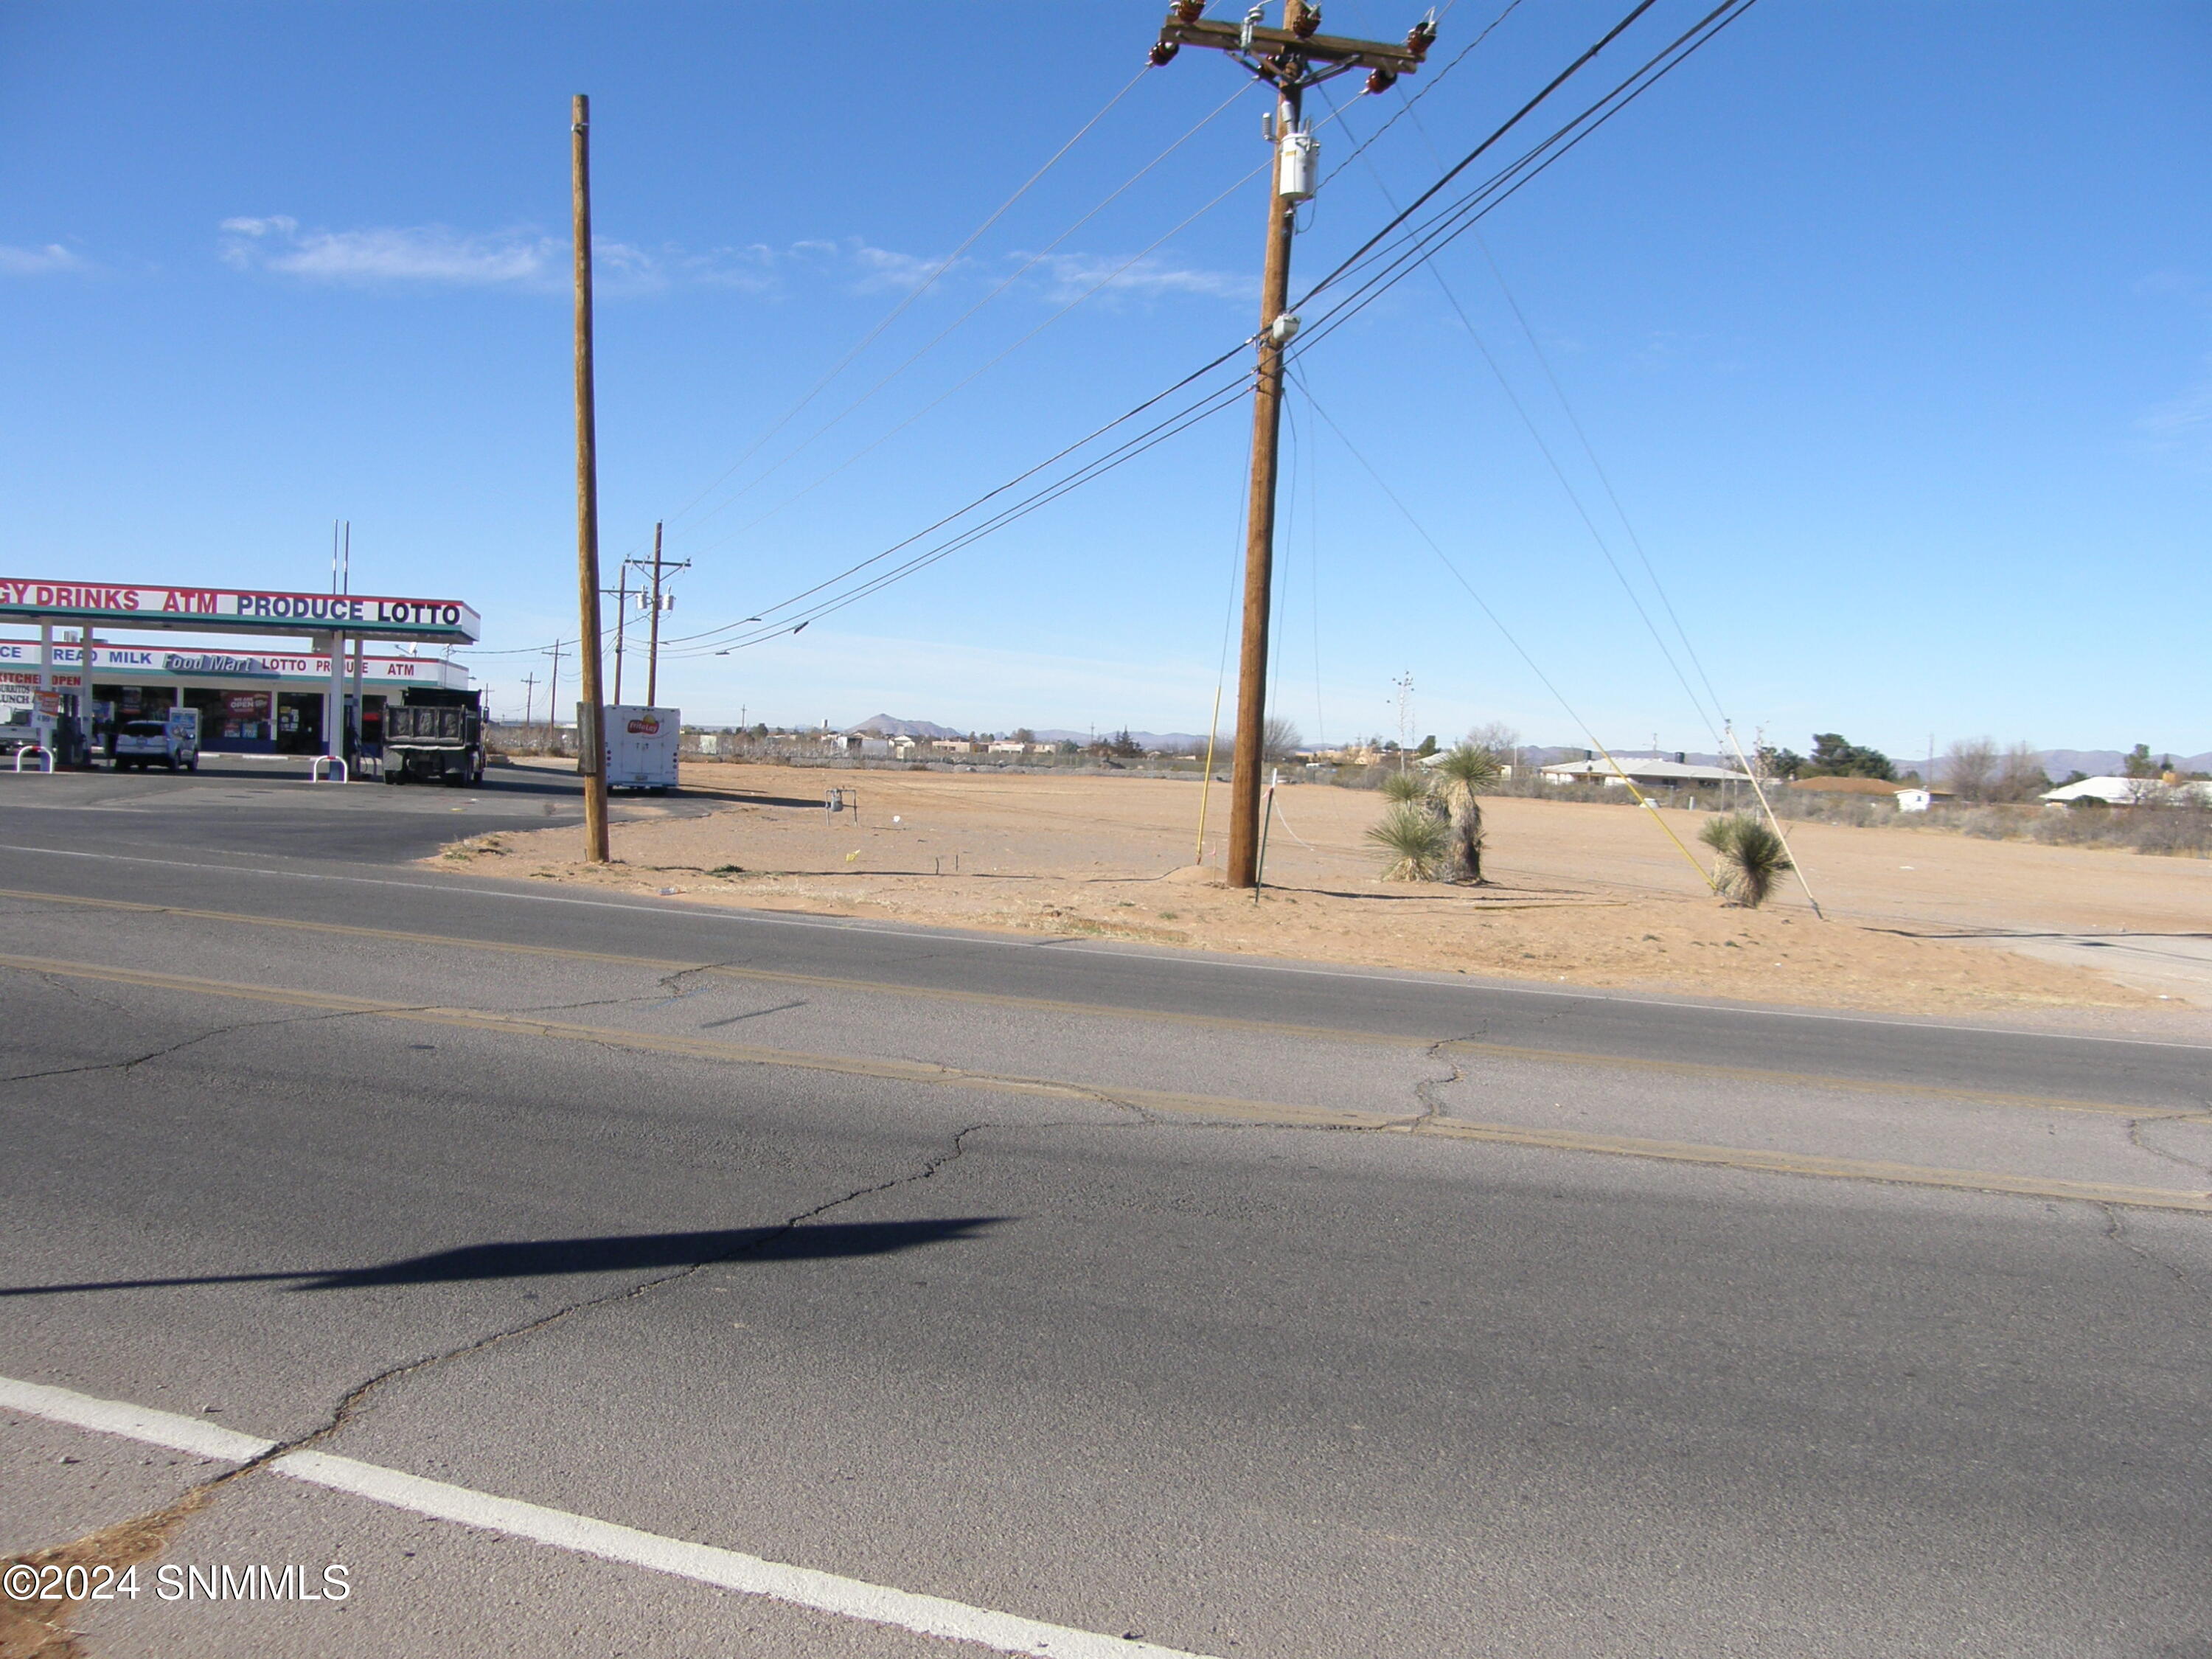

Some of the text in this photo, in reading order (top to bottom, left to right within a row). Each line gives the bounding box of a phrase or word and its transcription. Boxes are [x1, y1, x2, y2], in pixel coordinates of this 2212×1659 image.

[36, 586, 139, 611] DRINKS
[162, 591, 218, 614] ATM
[237, 595, 364, 620] PRODUCE
[378, 602, 460, 625] LOTTO
[52, 649, 98, 662] READ
[109, 651, 152, 664] MILK
[161, 653, 252, 672] Food Mart
[262, 658, 414, 676] LOTTO PRUE ATM
[52, 674, 81, 686] OPEN
[0, 695, 29, 703] UNCH
